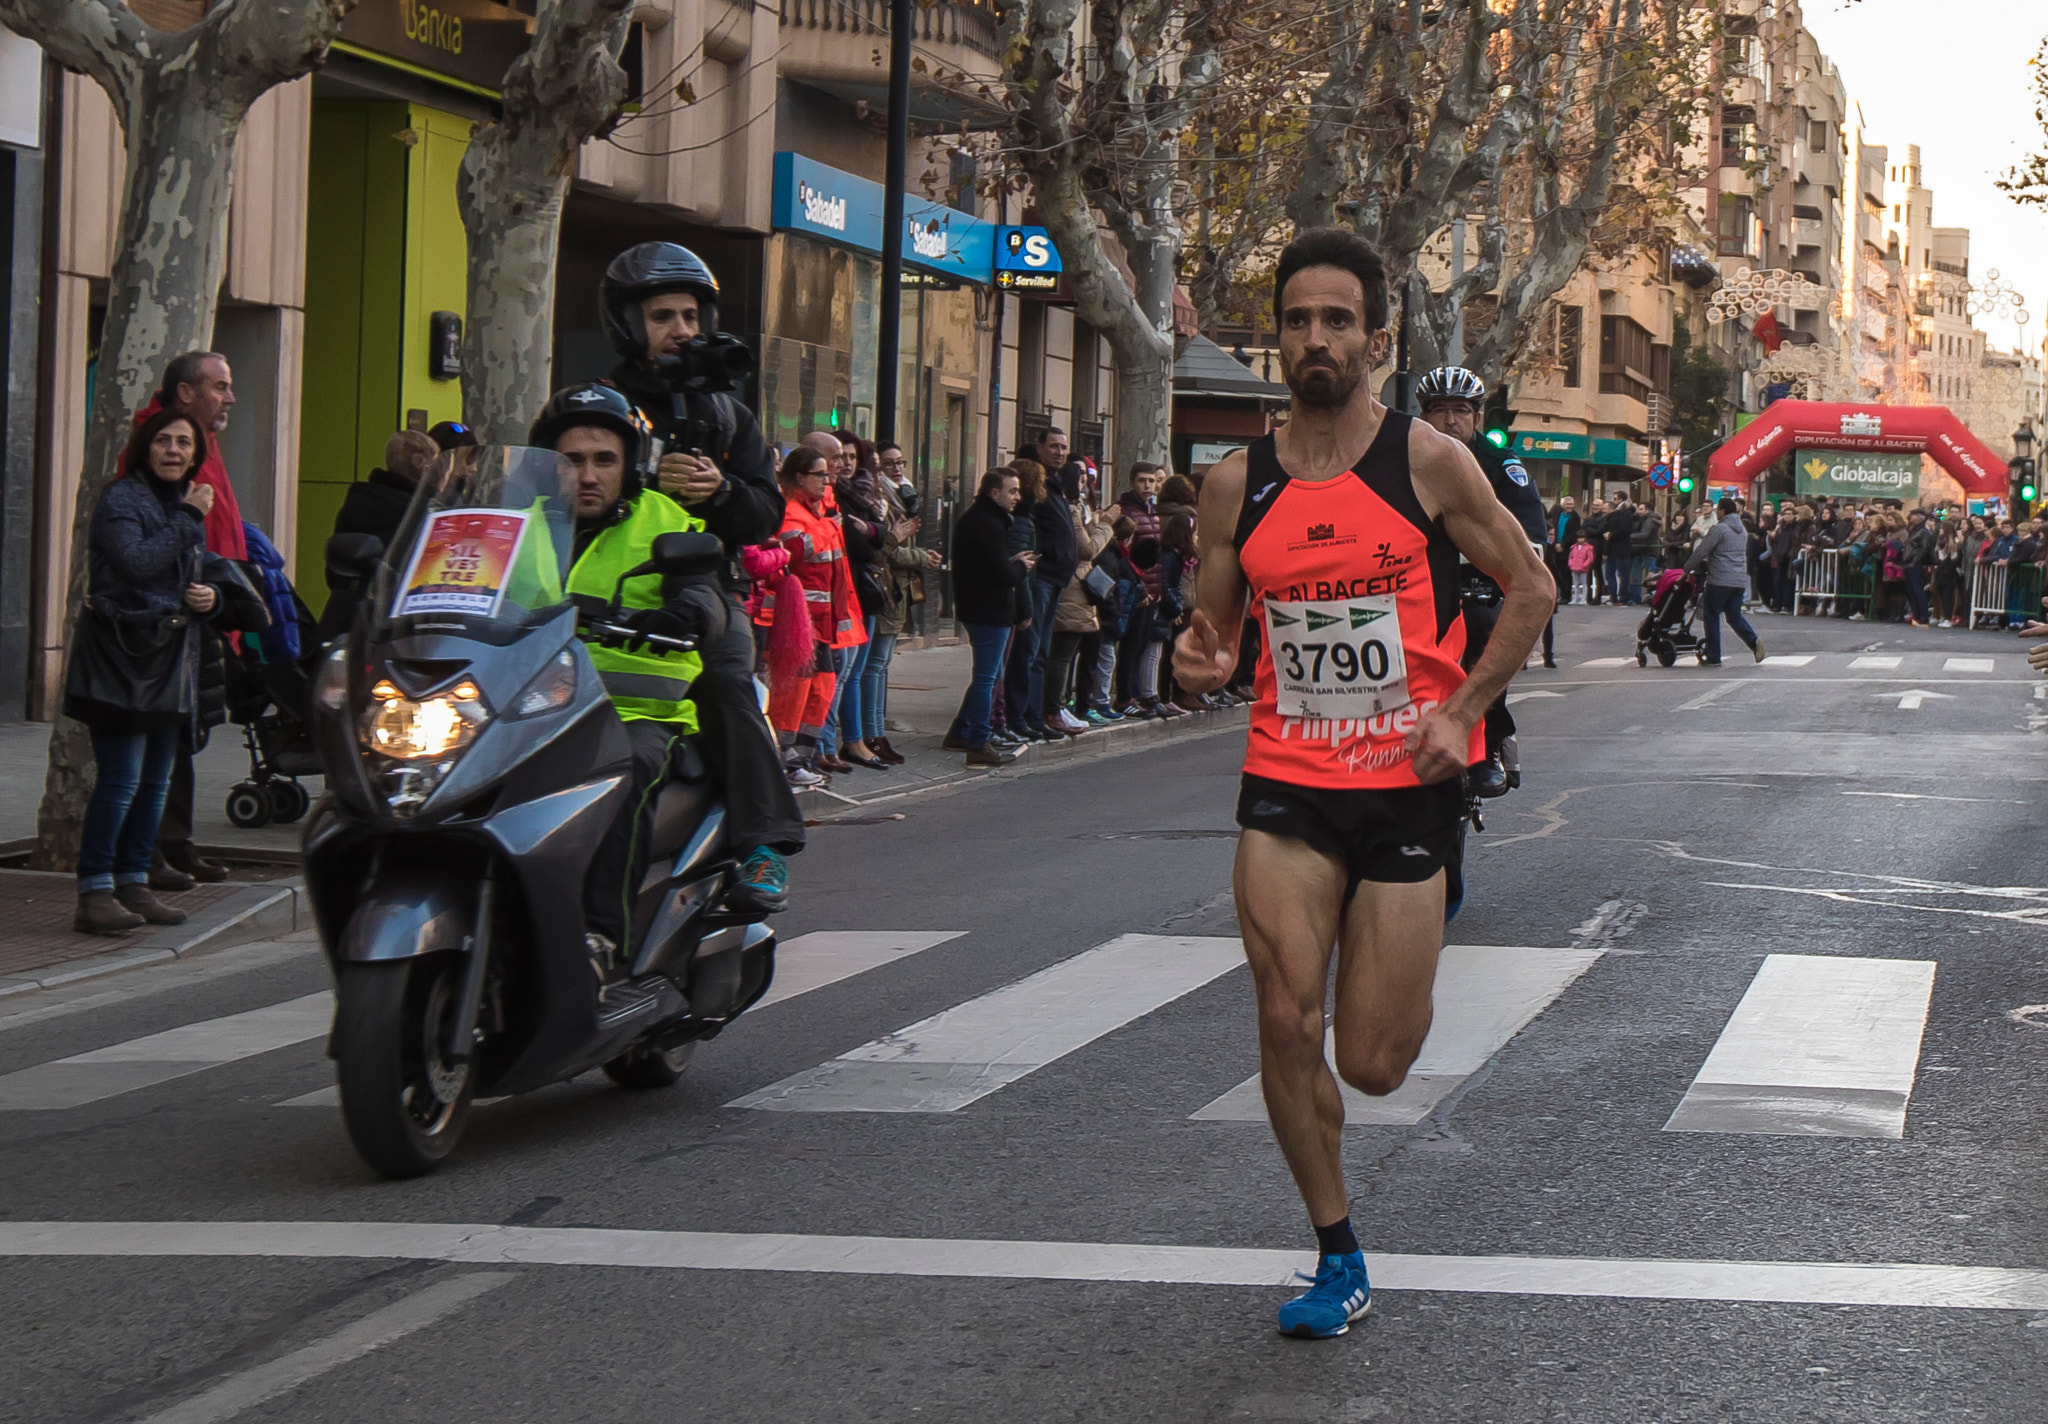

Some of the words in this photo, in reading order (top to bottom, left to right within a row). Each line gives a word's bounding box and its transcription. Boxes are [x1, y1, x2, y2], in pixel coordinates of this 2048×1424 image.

[804, 187, 846, 231] Sabadell
[913, 222, 948, 260] Sabadell
[1010, 234, 1020, 246] B
[1023, 235, 1049, 267] S
[1014, 275, 1055, 288] ServiRed
[1873, 440, 1927, 449] ALBACETE
[1830, 464, 1913, 489] Globalcaja
[1289, 571, 1409, 602] ALBACETE
[1280, 639, 1389, 683] 3790
[1283, 683, 1315, 695] CARRERA
[1316, 687, 1333, 695] SAN
[1338, 740, 1411, 774] Runni
